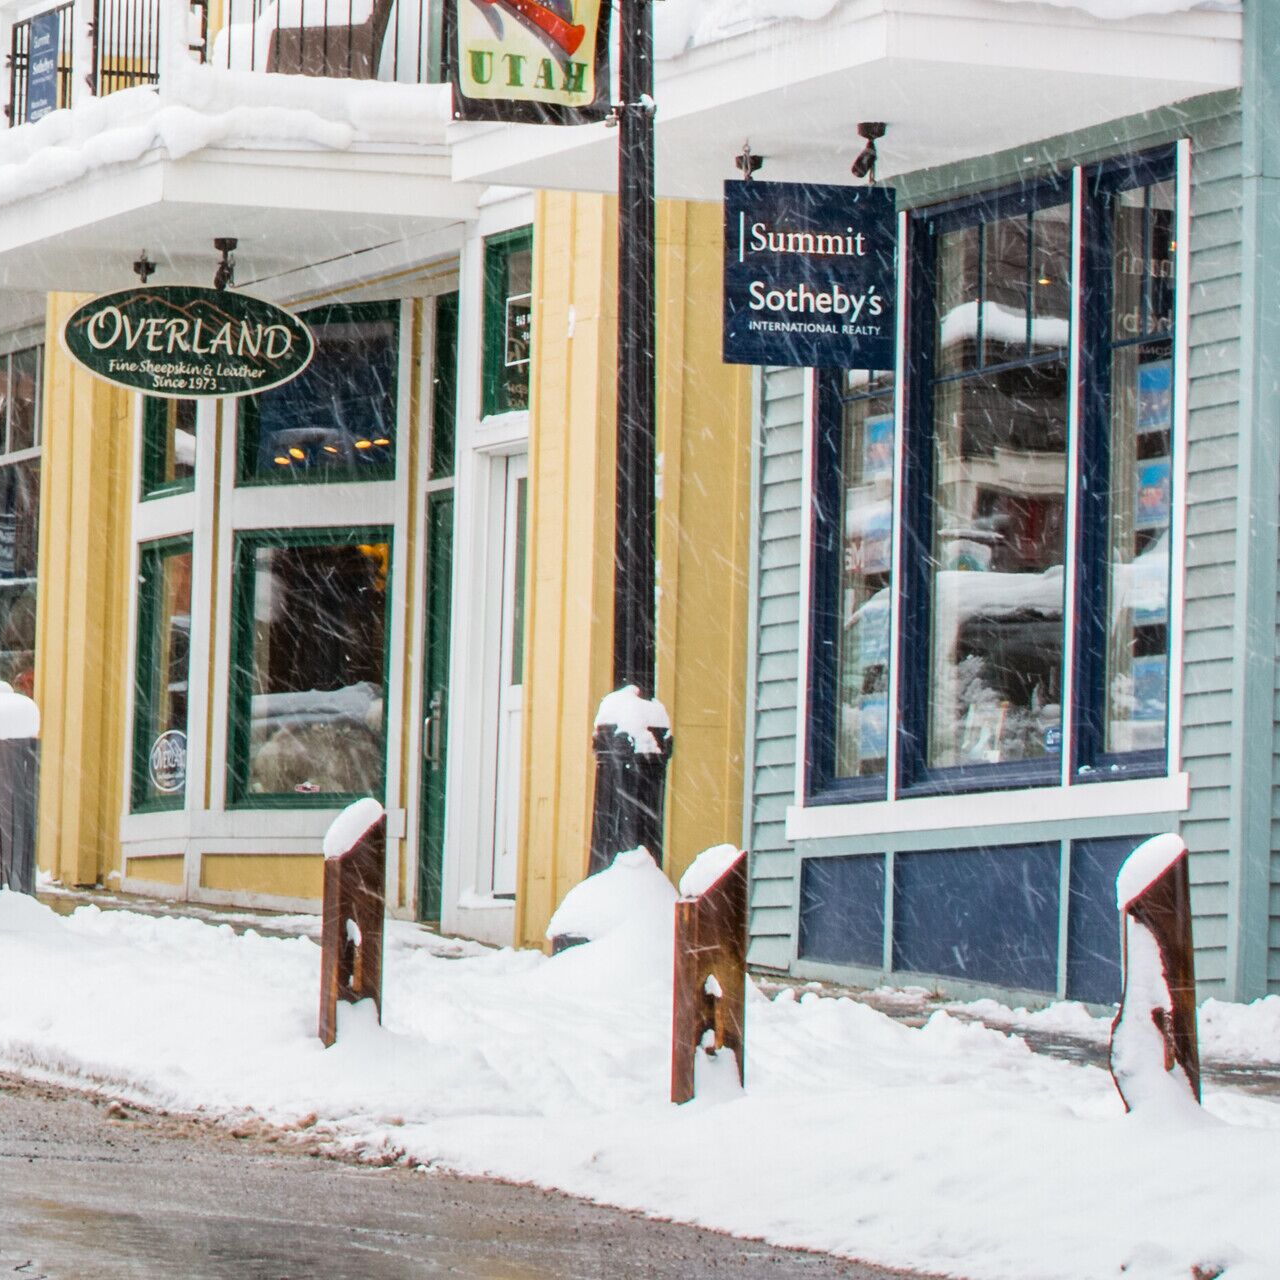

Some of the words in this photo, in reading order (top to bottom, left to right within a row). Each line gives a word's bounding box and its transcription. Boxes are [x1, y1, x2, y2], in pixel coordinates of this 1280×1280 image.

[468, 49, 589, 94] UTAH
[749, 222, 866, 257] Summit
[748, 280, 883, 323] Sotheby's
[87, 305, 294, 360] OVERLAND
[748, 320, 839, 335] INTERNATIONAL
[841, 323, 882, 336] REALTY
[108, 358, 139, 372] Fine
[140, 360, 202, 377] Sheepskin
[202, 363, 213, 376] &
[216, 363, 267, 379] Leather
[152, 376, 187, 389] Since
[188, 377, 218, 391] 1973
